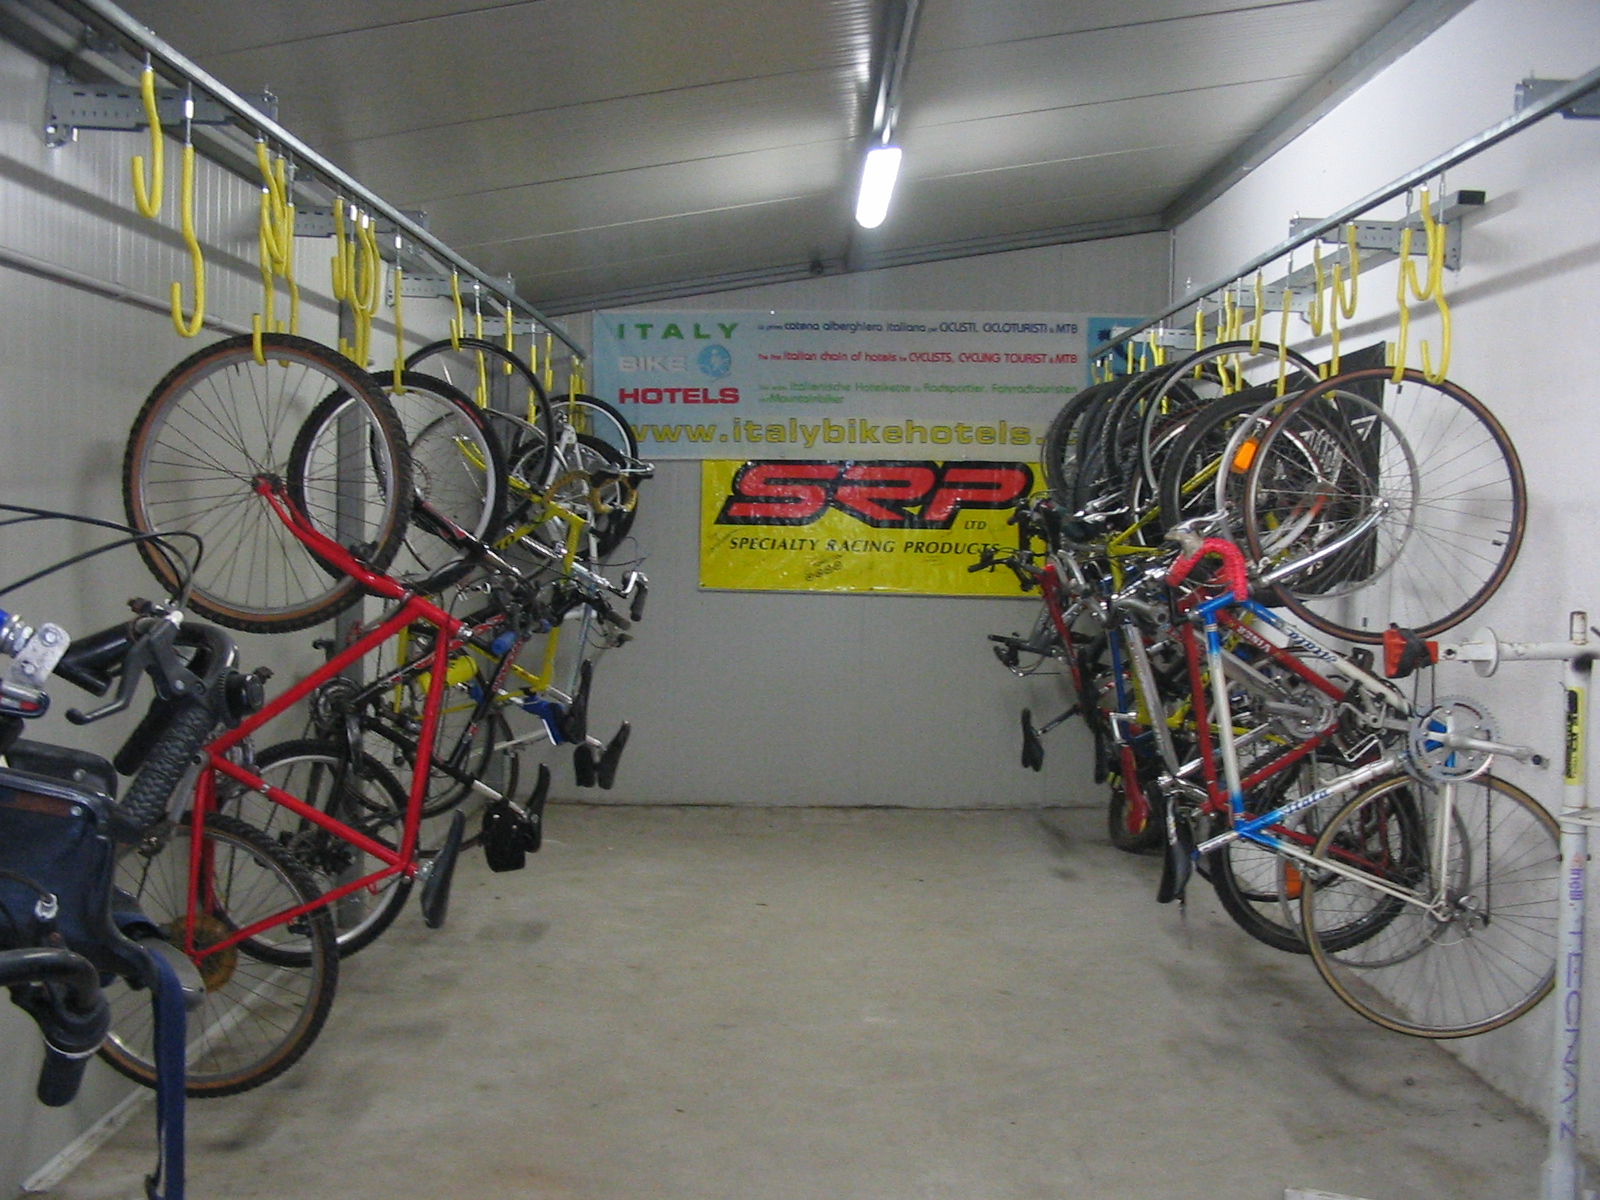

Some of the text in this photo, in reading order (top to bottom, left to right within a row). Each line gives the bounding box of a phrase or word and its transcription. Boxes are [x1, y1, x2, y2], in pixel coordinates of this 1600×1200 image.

[617, 323, 739, 339] ITALY
[785, 322, 820, 331] catena
[1056, 323, 1078, 333] MTB
[618, 355, 688, 372] BIKE
[820, 351, 848, 361] chain
[851, 351, 862, 361] of
[864, 352, 897, 362] hotels
[958, 353, 1001, 363] CYCLING
[1004, 353, 1047, 363] TOURIST
[1056, 354, 1078, 363] MTB
[618, 387, 740, 405] HOTELS
[631, 417, 1080, 448] www.italybikehotels.
[722, 462, 1030, 526] SRP
[963, 519, 987, 530] LTD
[729, 536, 1002, 557] SPECIALTY RACING PRODUCTS
